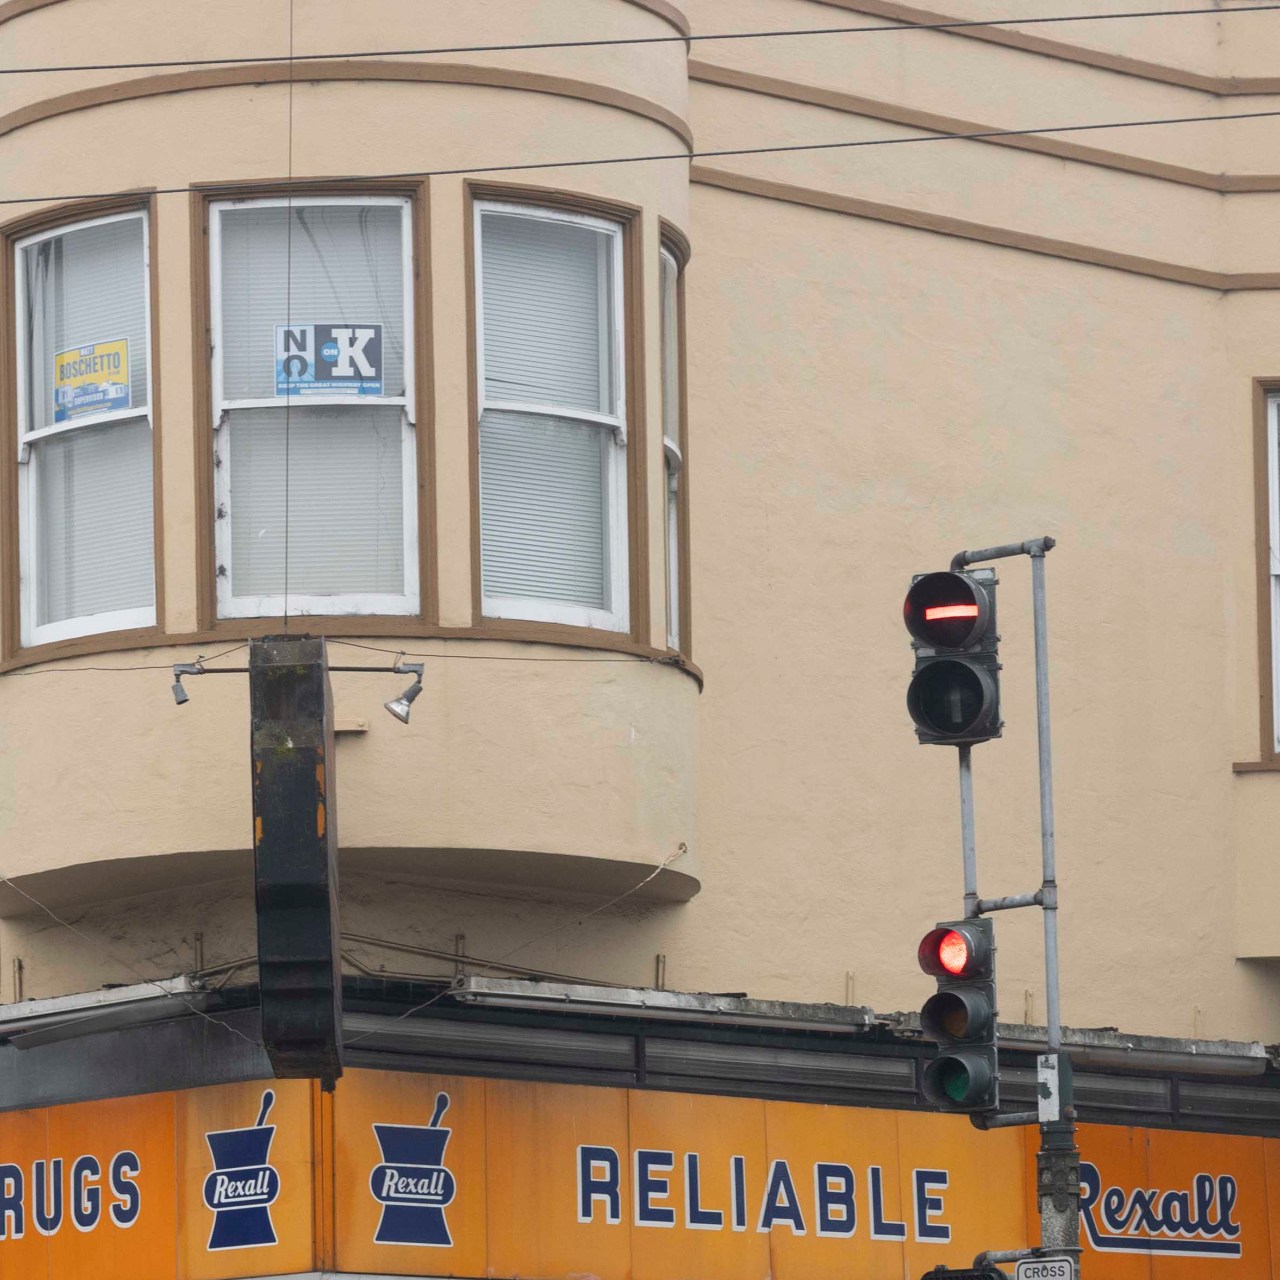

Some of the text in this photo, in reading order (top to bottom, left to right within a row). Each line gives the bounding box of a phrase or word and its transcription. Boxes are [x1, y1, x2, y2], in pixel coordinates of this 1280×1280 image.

[59, 351, 121, 381] BOSCHETTO
[323, 328, 376, 377] ON K
[211, 1169, 271, 1203] Rexall
[380, 1167, 446, 1200] Rexall
[576, 1144, 951, 1244] RELIABLE
[1024, 1265, 1065, 1279] CROSS
